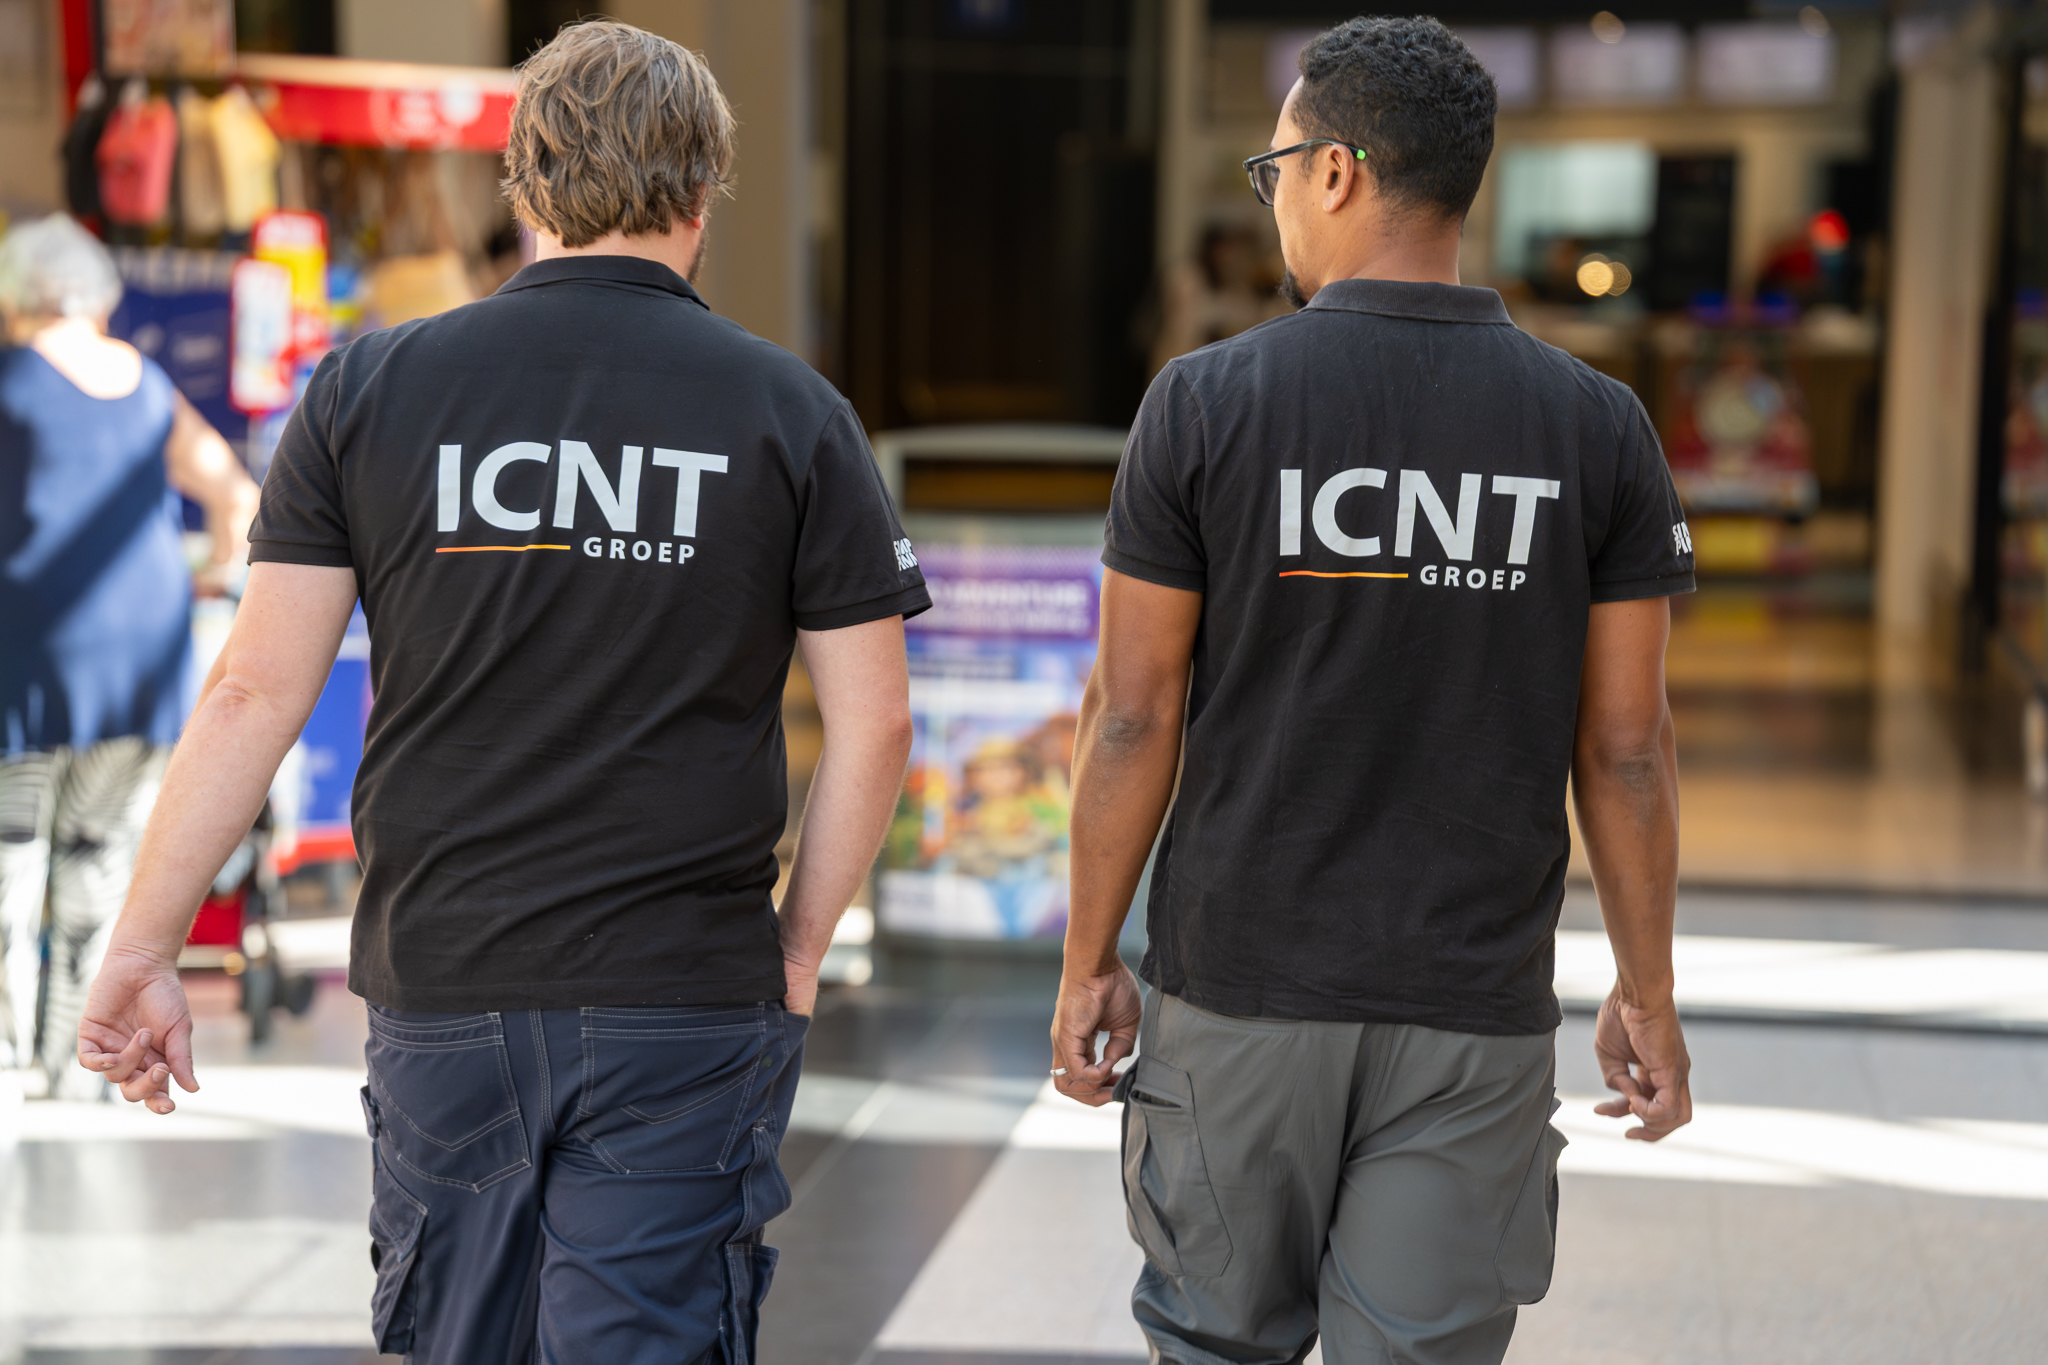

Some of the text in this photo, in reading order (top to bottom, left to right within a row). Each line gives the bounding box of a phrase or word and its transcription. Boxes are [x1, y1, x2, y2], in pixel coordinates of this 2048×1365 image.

[437, 439, 729, 537] ICNT
[1279, 467, 1561, 565] ICNT
[582, 536, 696, 565] GROEP
[1419, 564, 1527, 591] GROEP
